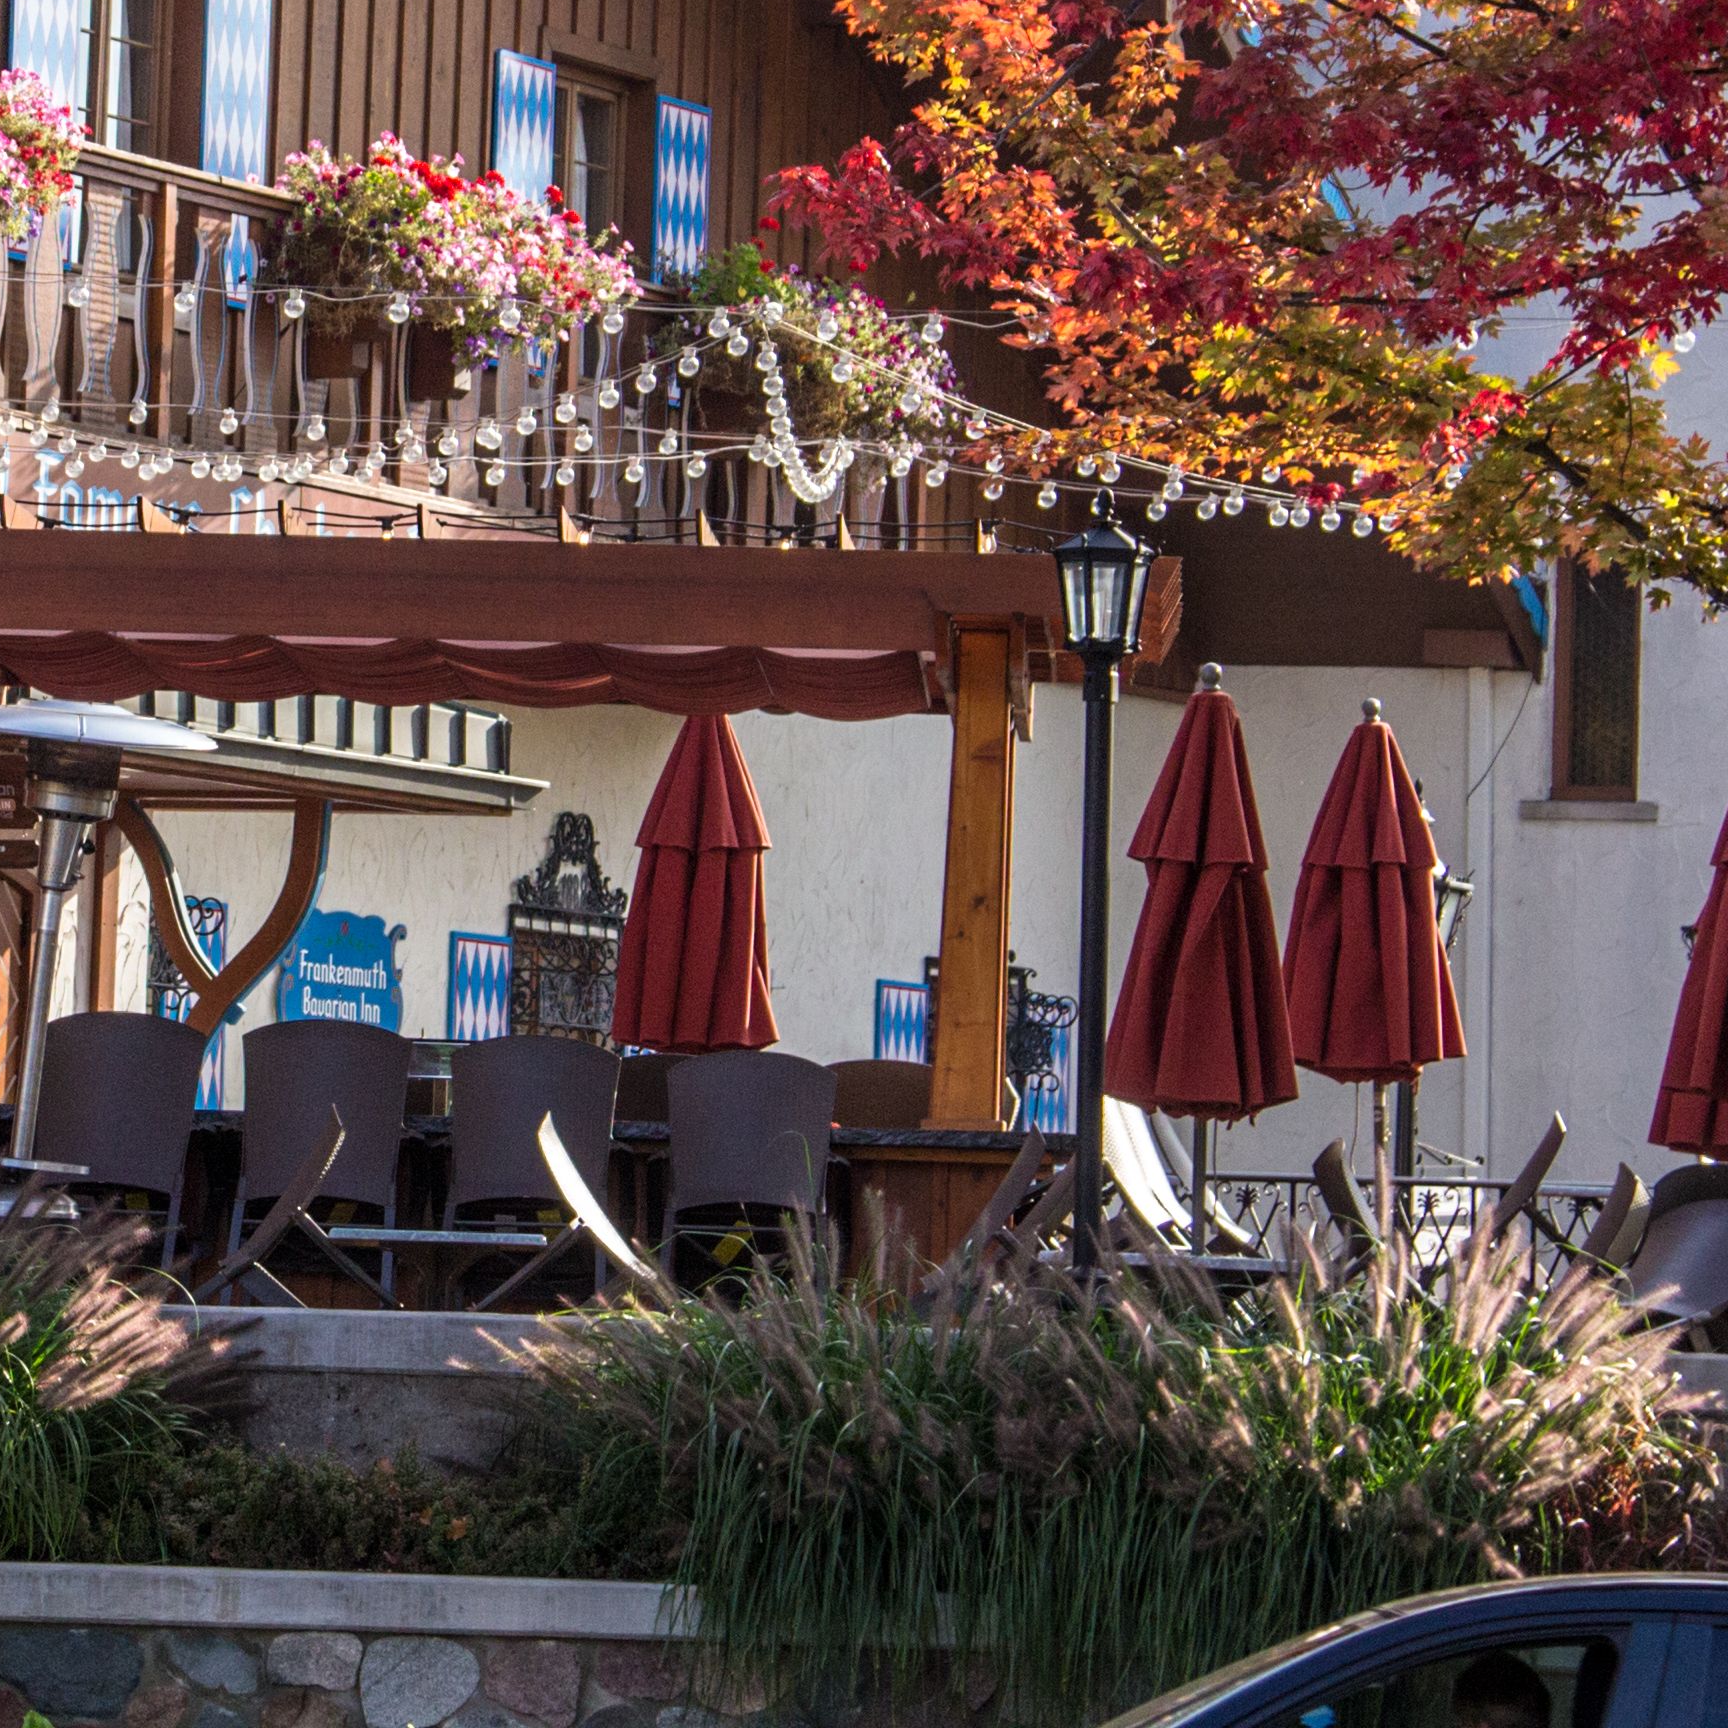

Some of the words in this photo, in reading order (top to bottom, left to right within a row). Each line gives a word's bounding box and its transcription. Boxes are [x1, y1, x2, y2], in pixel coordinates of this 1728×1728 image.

[300, 949, 387, 990] Frankenmuth
[303, 986, 356, 1022] Bavarian
[361, 993, 381, 1024] Inn
